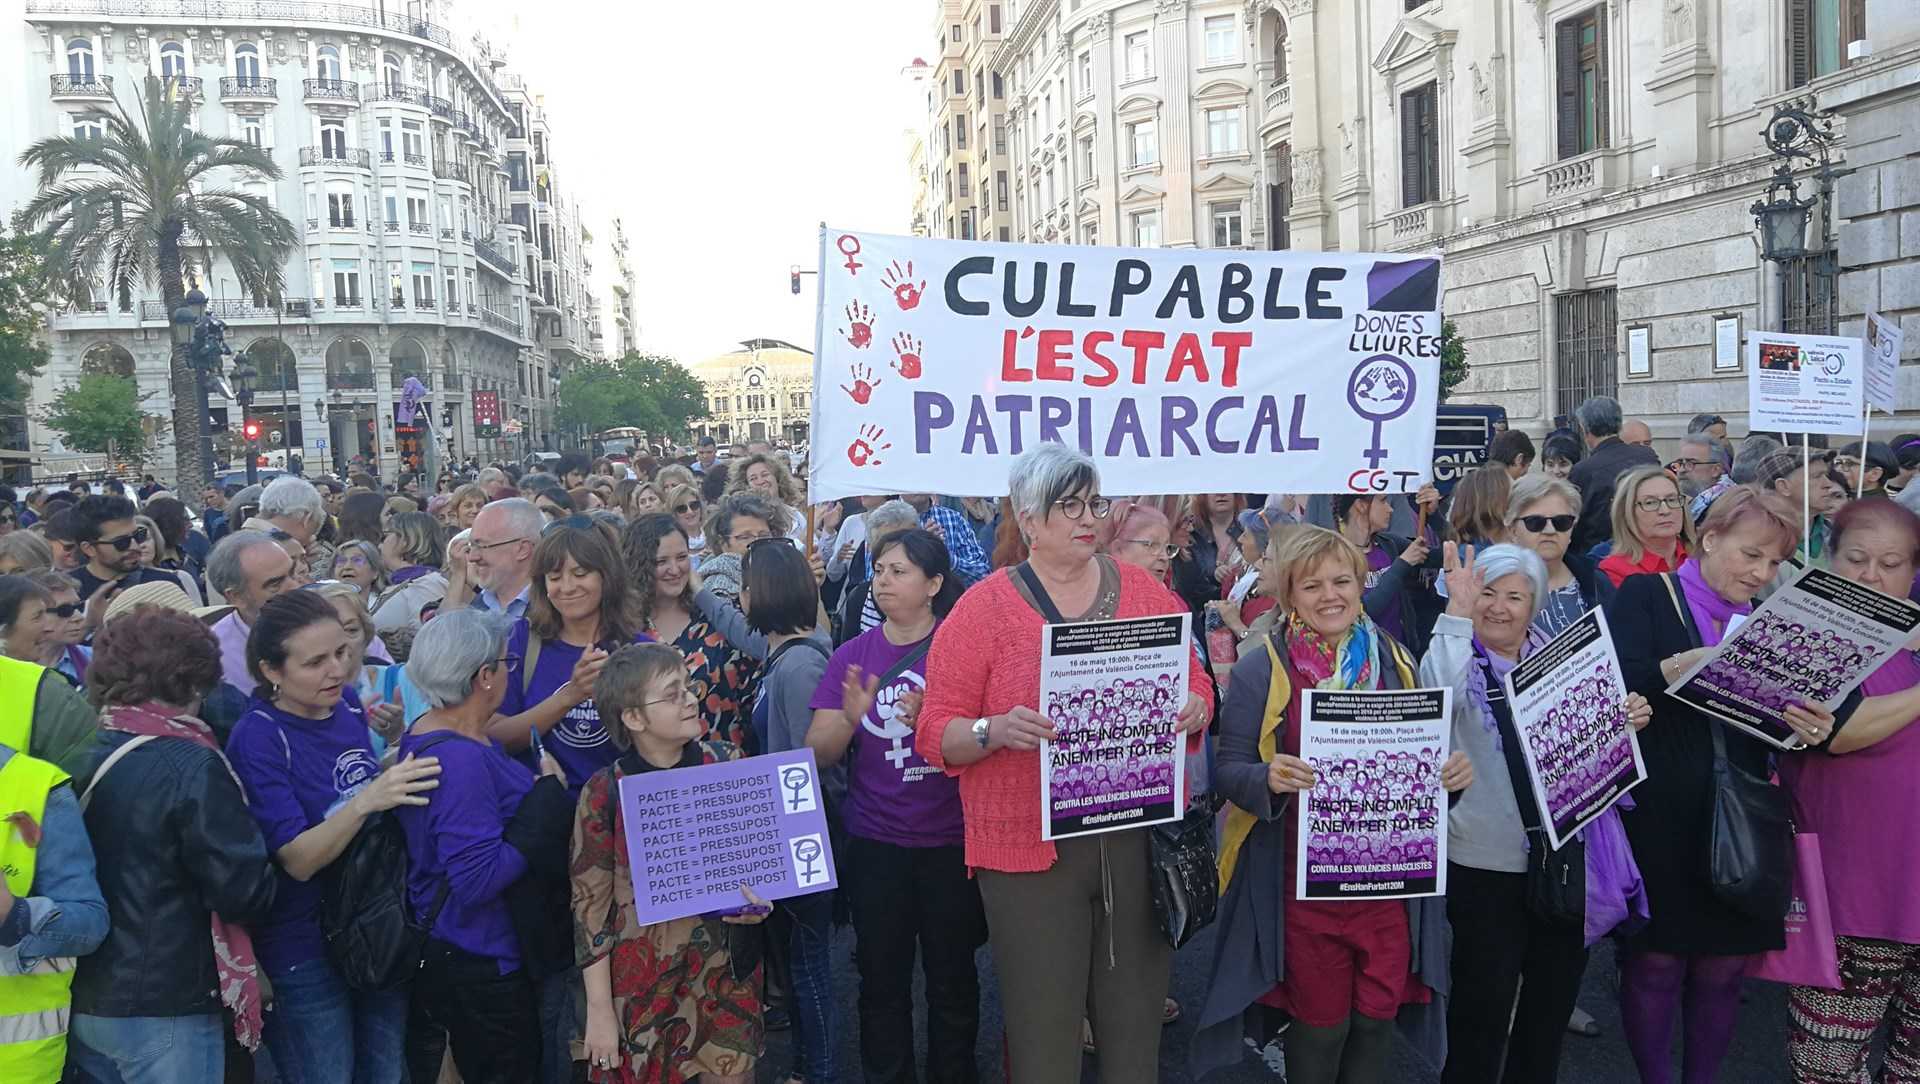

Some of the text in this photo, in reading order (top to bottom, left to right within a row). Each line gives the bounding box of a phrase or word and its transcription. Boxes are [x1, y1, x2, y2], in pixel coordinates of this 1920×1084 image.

[944, 256, 1347, 322] CULPABLE
[1354, 313, 1424, 334] DONES
[1349, 333, 1443, 357] LLIURES
[914, 391, 1320, 458] PATRIARCAL
[1349, 469, 1419, 493] CGT
[1090, 658, 1106, 667] maig
[1134, 654, 1152, 663] Plaça
[1719, 649, 1831, 704] ANEM PER TOTES
[1051, 722, 1173, 746] PACTE INCOMPLIT
[1351, 728, 1368, 736] maig
[1052, 742, 1173, 767] ANEM PER TOTES
[1544, 720, 1625, 785] ANEM PER TOTES
[639, 789, 678, 805] PACTE
[693, 774, 771, 794] PRESSUPOST
[640, 803, 680, 818] PACTE
[694, 788, 773, 809] PRESSUPOST
[1055, 800, 1080, 810] CONTRA
[1081, 798, 1093, 806] LES
[1131, 786, 1169, 799] MASCLISTES
[1312, 797, 1435, 812] PACTE INCOMPLIT
[642, 818, 682, 832] PACTE
[696, 802, 775, 823] PRESSUPOST
[643, 832, 684, 847] PACTE
[698, 816, 778, 837] PRESSUPOST
[1311, 817, 1435, 832] ANEM PER TOTES
[645, 846, 687, 861] PACTE
[701, 829, 780, 851] PRESSUPOST
[647, 860, 688, 876] PACTE
[703, 843, 783, 865] PRESSUPOST
[649, 874, 690, 890] PACTE
[705, 857, 785, 879] PRESSUPOST
[1311, 865, 1339, 873] CONTRA
[1340, 865, 1353, 873] LES
[1392, 861, 1432, 871] MASCLISTES
[651, 888, 693, 905] PACTE
[707, 871, 787, 894] PRESSUPOST
